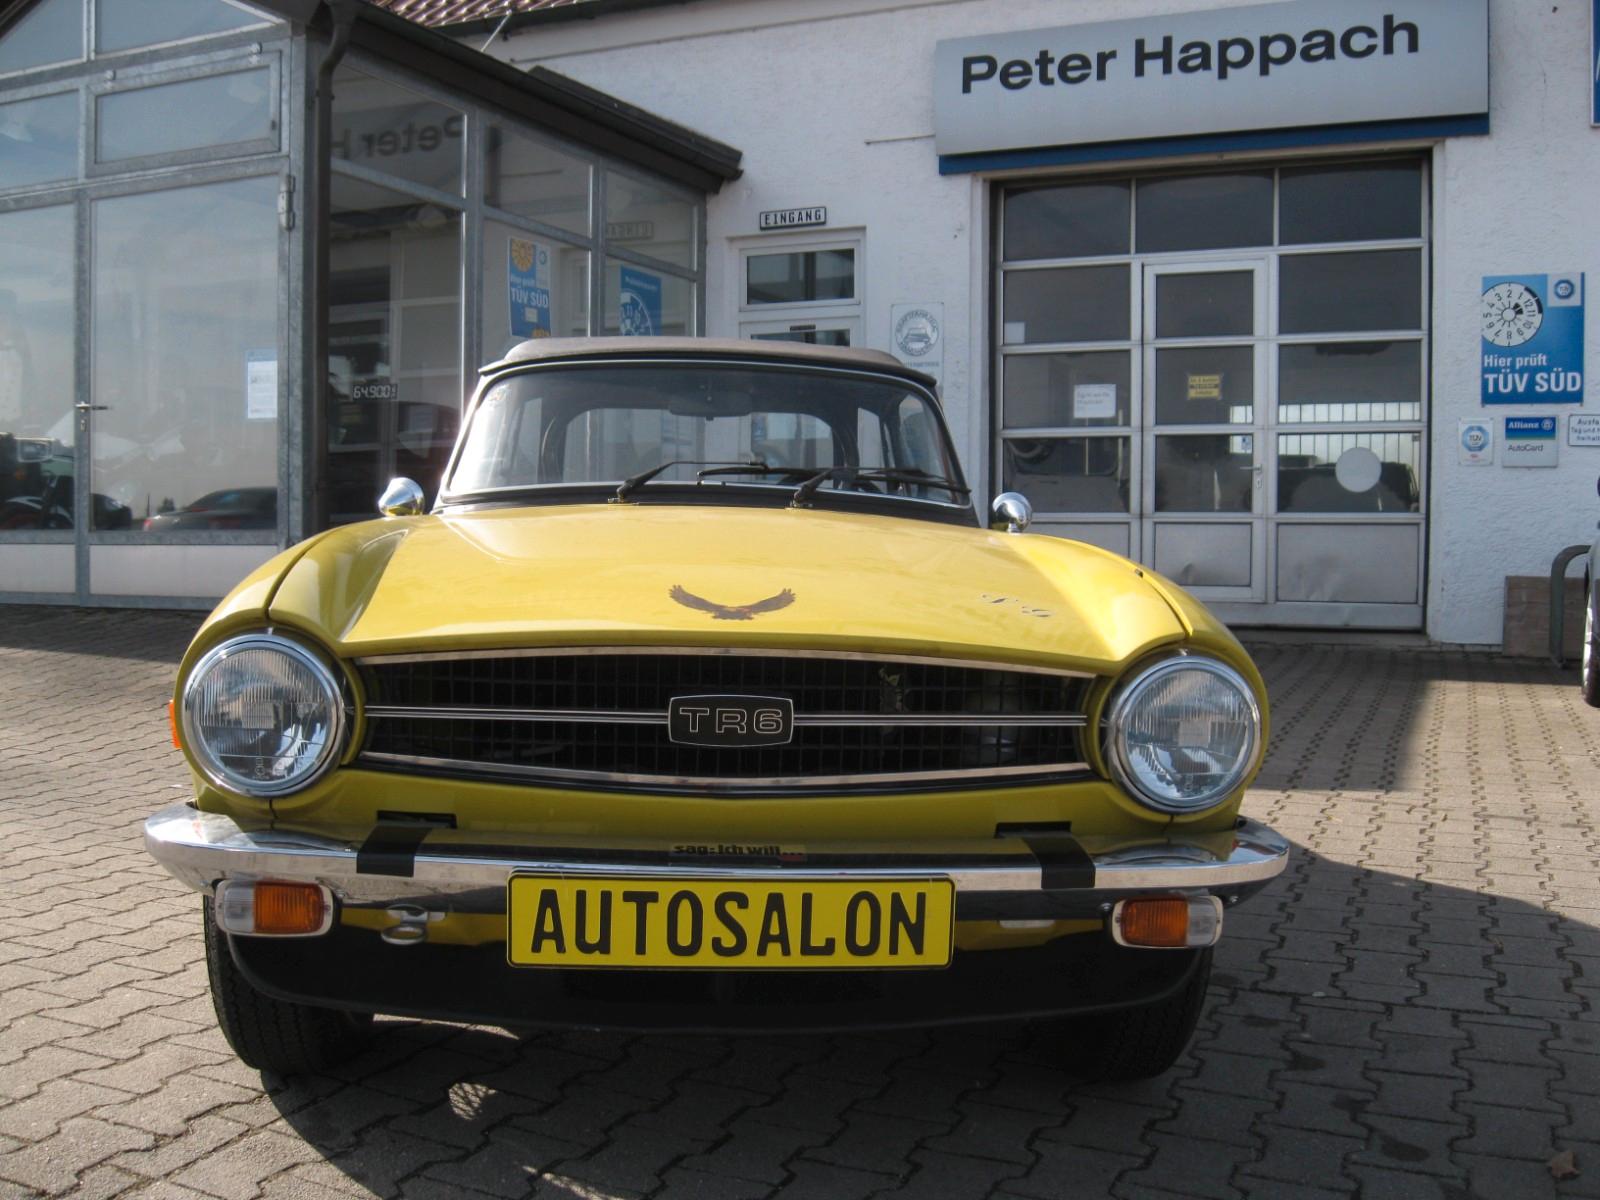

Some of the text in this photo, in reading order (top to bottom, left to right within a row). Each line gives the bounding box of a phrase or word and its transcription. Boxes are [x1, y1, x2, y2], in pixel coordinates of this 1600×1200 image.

[962, 14, 1419, 94] Peter Happach
[764, 208, 822, 226] EINGANG
[1507, 289, 1513, 298] 2
[1484, 353, 1547, 370] Hier prüft
[1484, 367, 1581, 393] TÜV SÜD
[1507, 420, 1540, 429] Allianz
[1508, 443, 1544, 452] AutoCard
[679, 707, 783, 734] TR6
[530, 888, 927, 957] AUTOSALON
